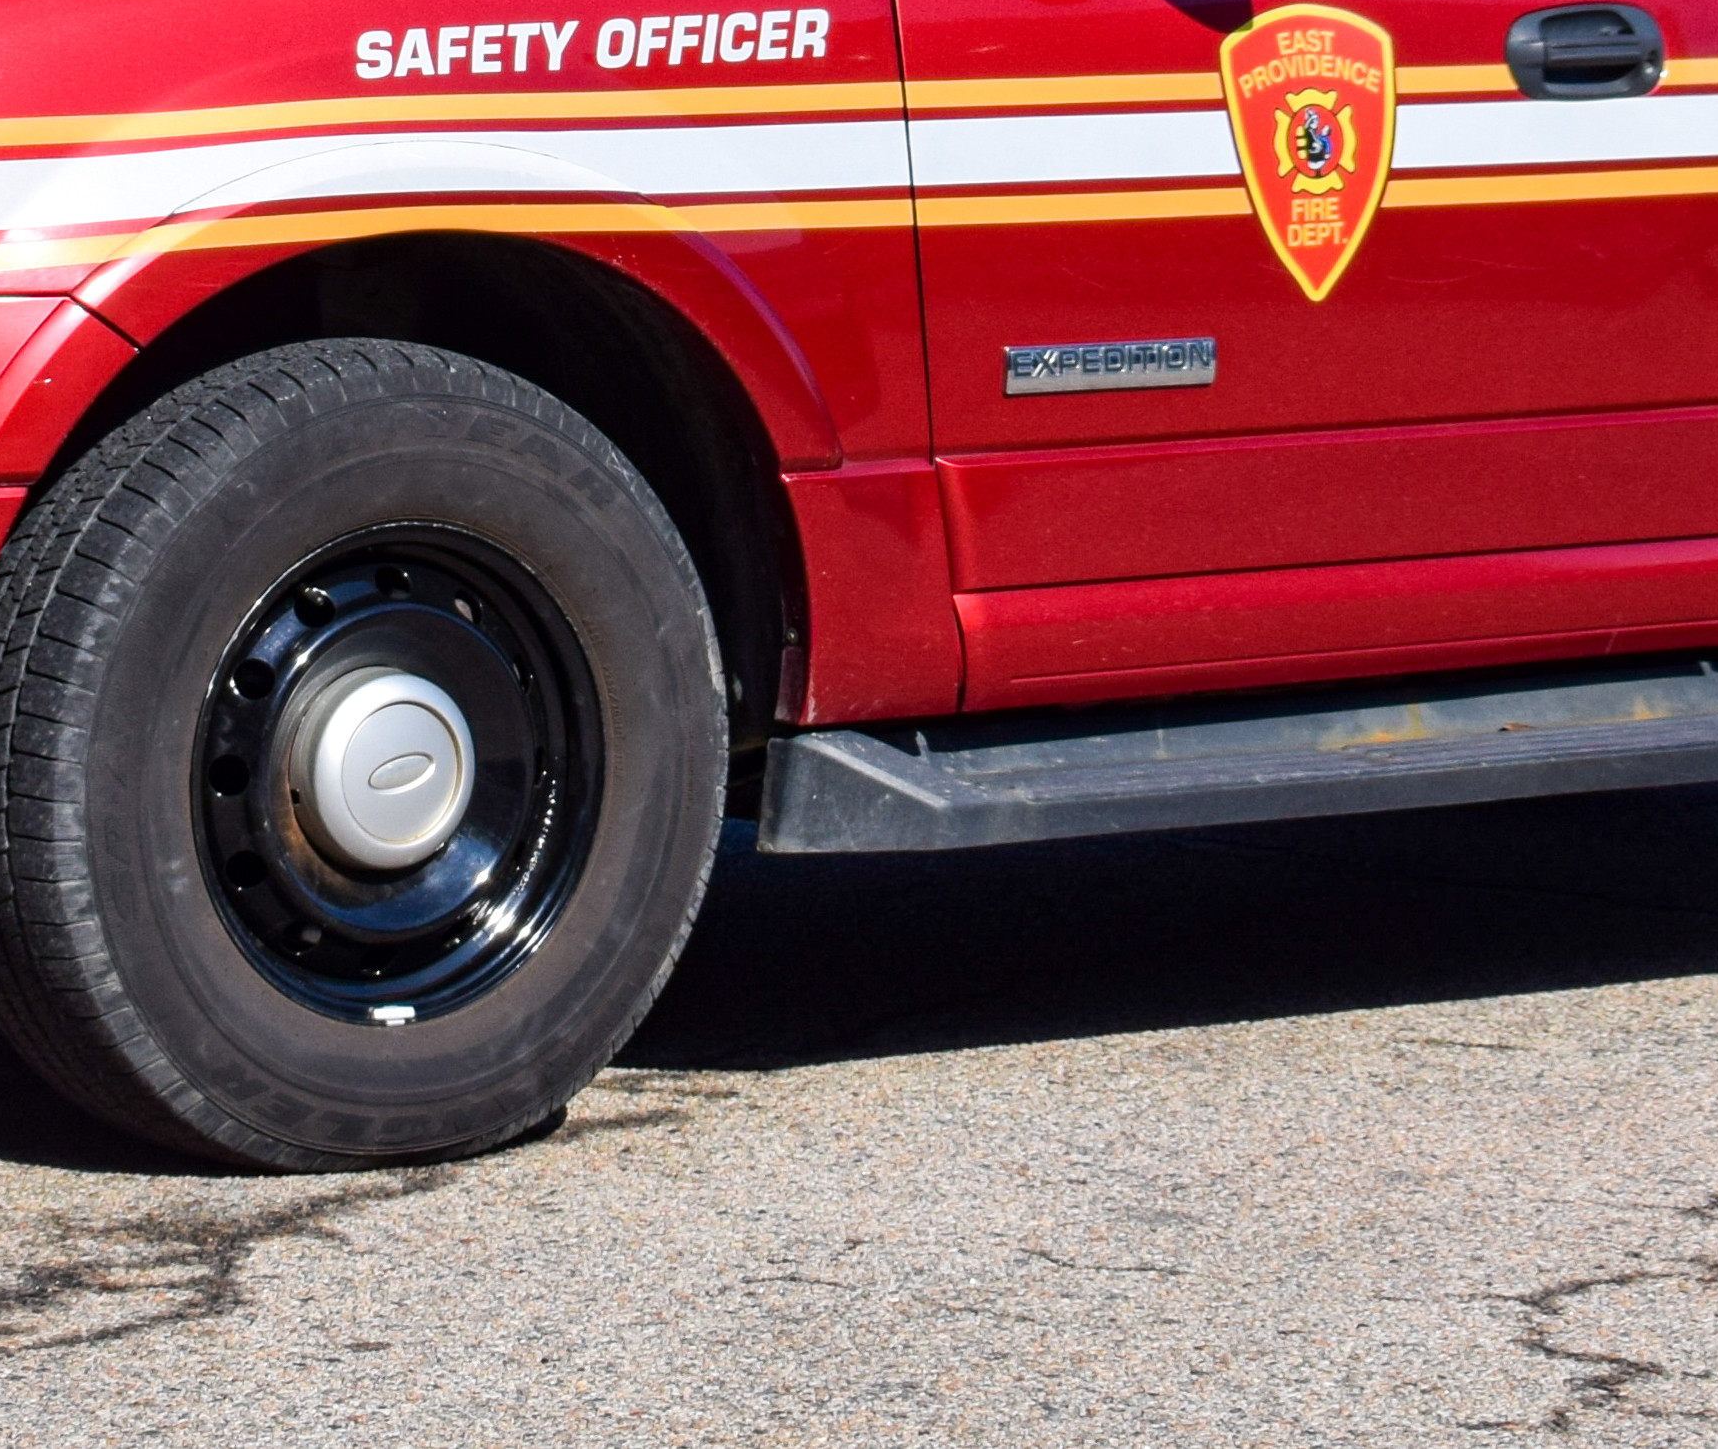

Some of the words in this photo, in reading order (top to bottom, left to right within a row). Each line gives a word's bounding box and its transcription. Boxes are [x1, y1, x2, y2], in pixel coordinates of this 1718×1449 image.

[356, 20, 580, 80] SAFETY
[596, 8, 830, 69] OFFICER
[1276, 30, 1335, 55] EAST
[1238, 54, 1382, 99] PROVIDENCE
[1291, 197, 1341, 221] FIRE
[1287, 222, 1348, 247] DEPT.
[1010, 341, 1213, 379] EXPEDITION
